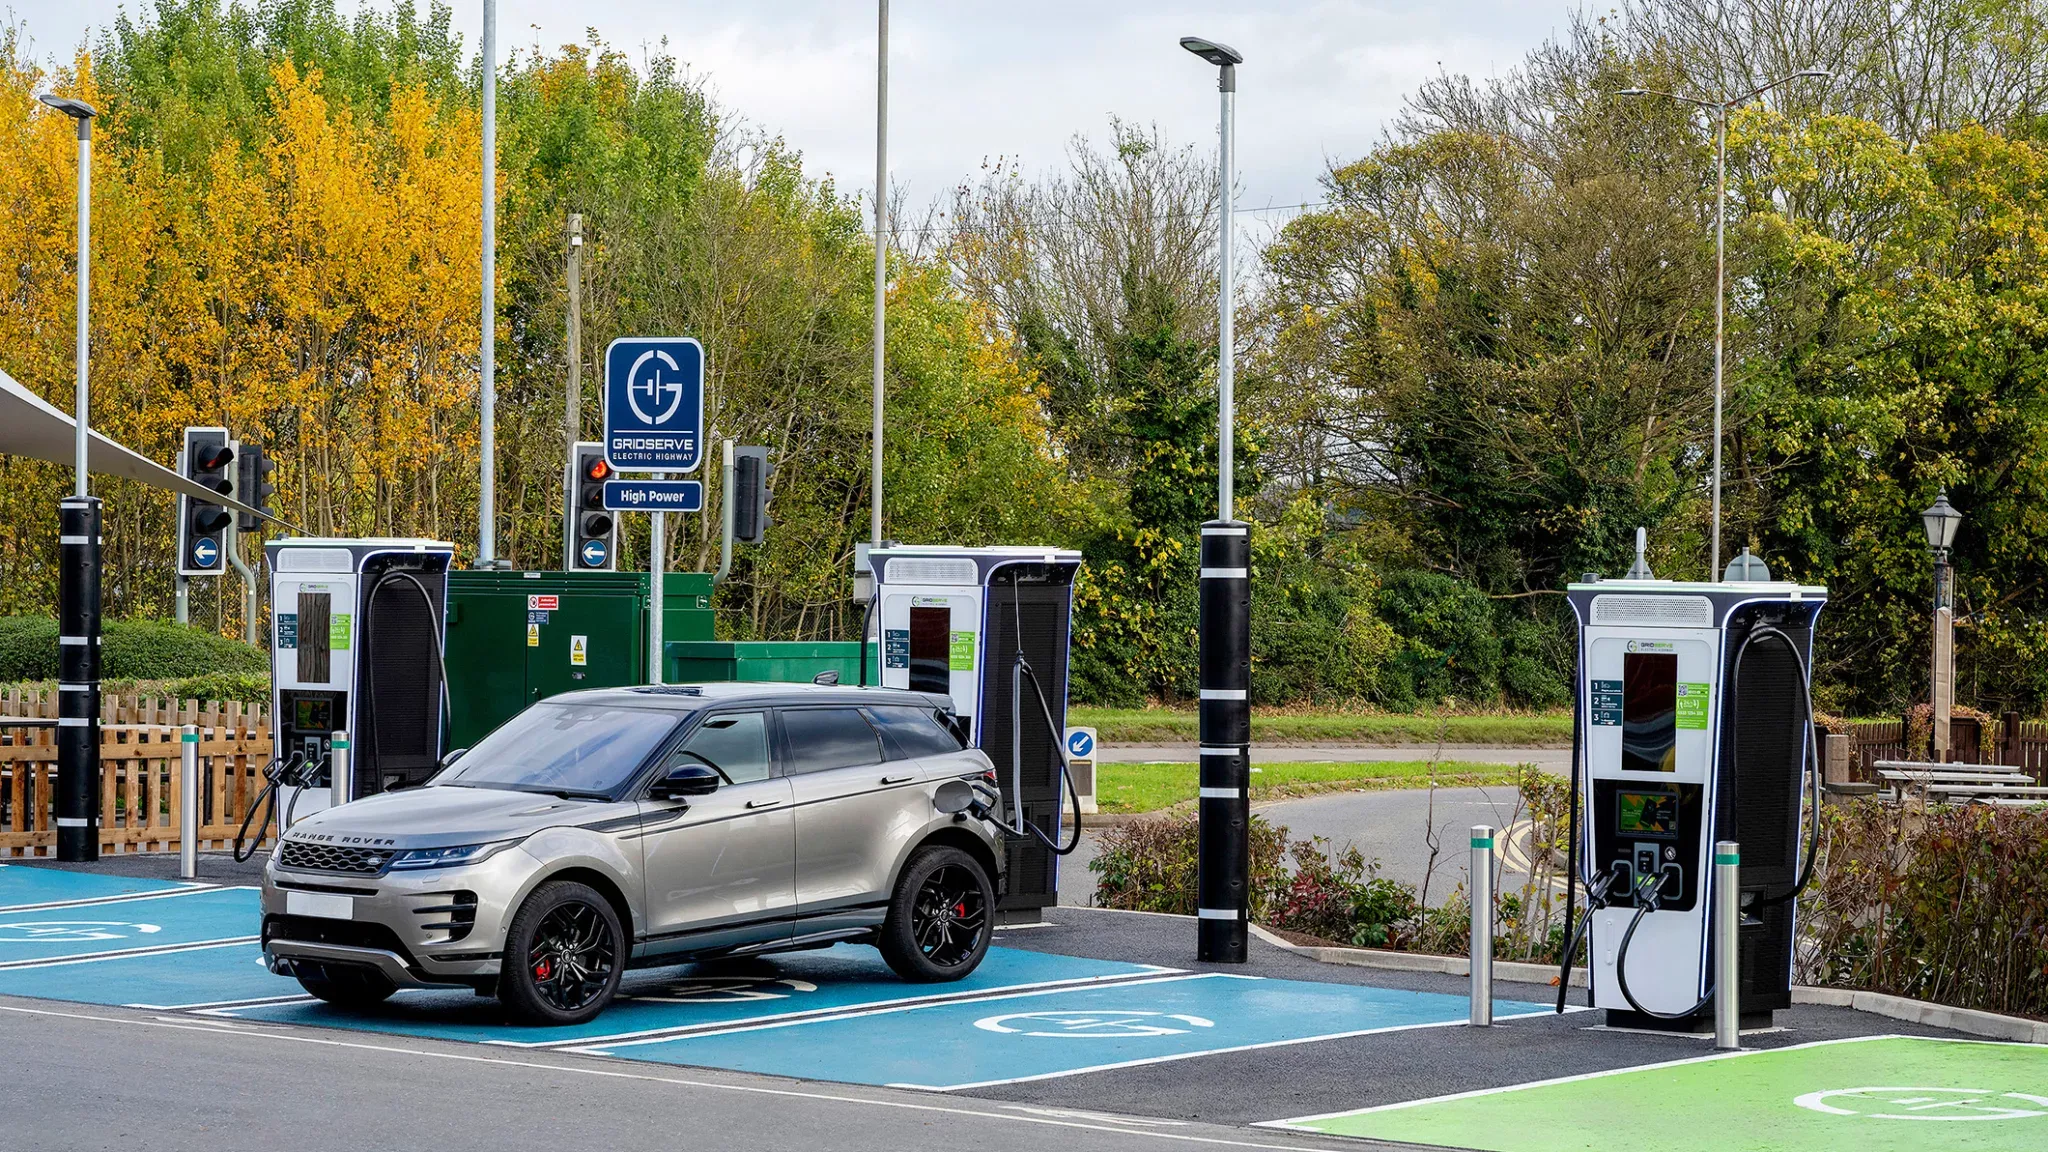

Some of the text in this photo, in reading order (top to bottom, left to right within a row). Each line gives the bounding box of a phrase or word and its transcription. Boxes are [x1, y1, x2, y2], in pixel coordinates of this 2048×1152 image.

[612, 438, 694, 450] GRIDSERVE
[612, 452, 693, 461] ELECTRIC HIGHWAY
[620, 489, 685, 504] High Power
[292, 832, 395, 845] RANGE ROVER
